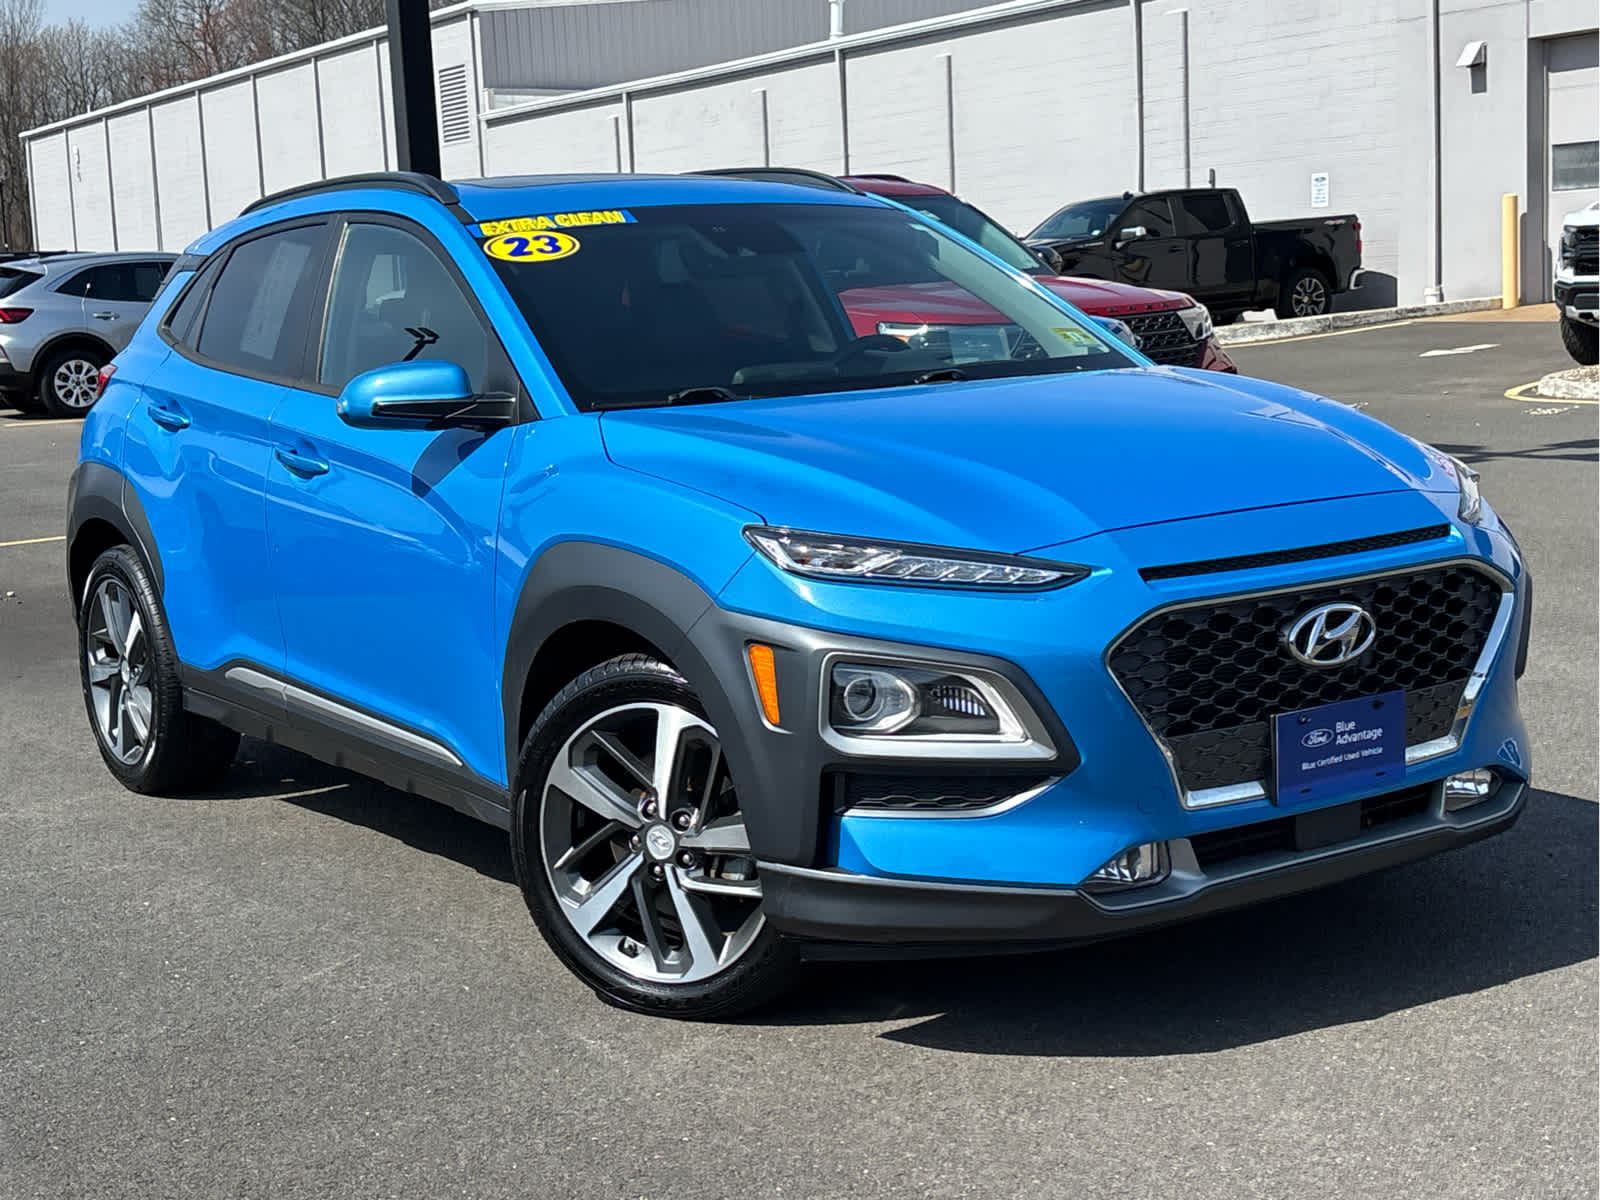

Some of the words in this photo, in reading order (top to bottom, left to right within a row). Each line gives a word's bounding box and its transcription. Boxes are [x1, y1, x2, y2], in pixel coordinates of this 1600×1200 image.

[479, 216, 556, 236] EXTRA
[554, 211, 626, 227] CLEAN
[503, 235, 561, 257] 23
[1336, 721, 1356, 733] Blue
[1307, 731, 1328, 745] Ford
[1336, 728, 1383, 745] Advantage
